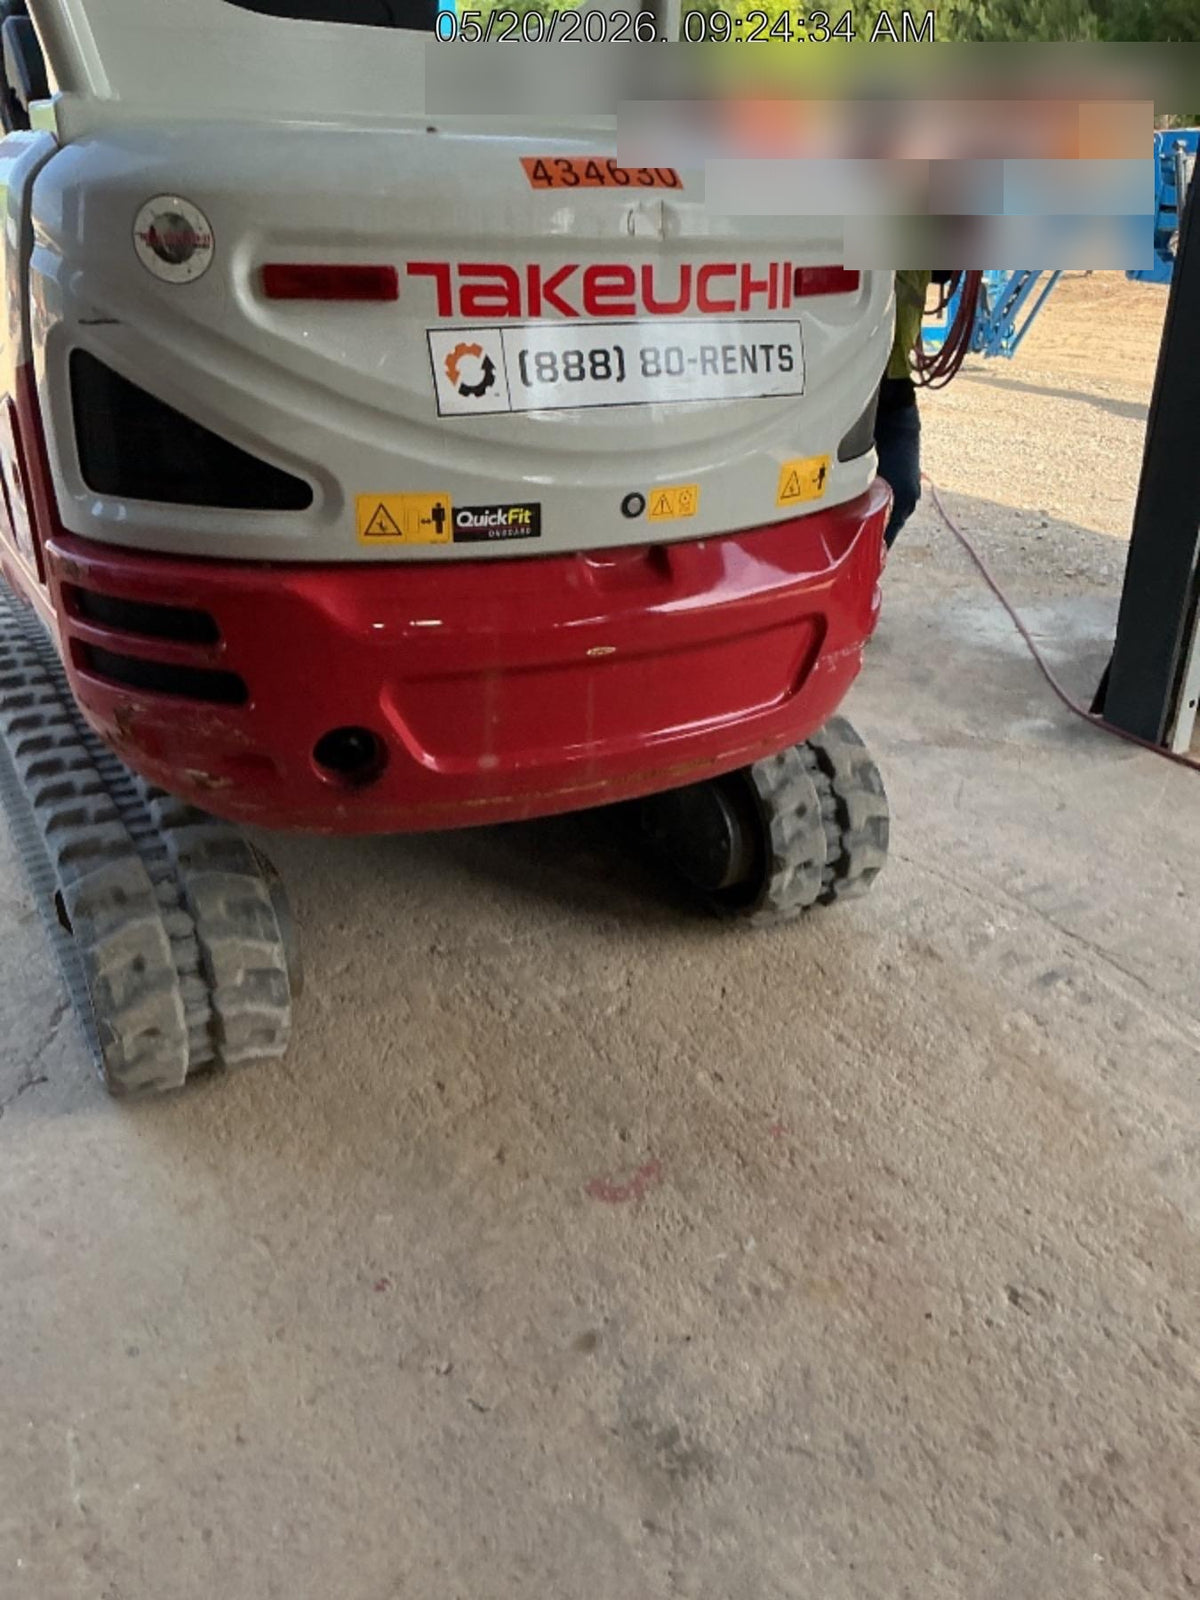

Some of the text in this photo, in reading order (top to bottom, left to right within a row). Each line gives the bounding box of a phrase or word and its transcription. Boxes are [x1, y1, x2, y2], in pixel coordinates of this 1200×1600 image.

[532, 159, 678, 187] 434630
[519, 344, 794, 387] (888) 80-RENTS
[456, 508, 532, 527] QuickFit
